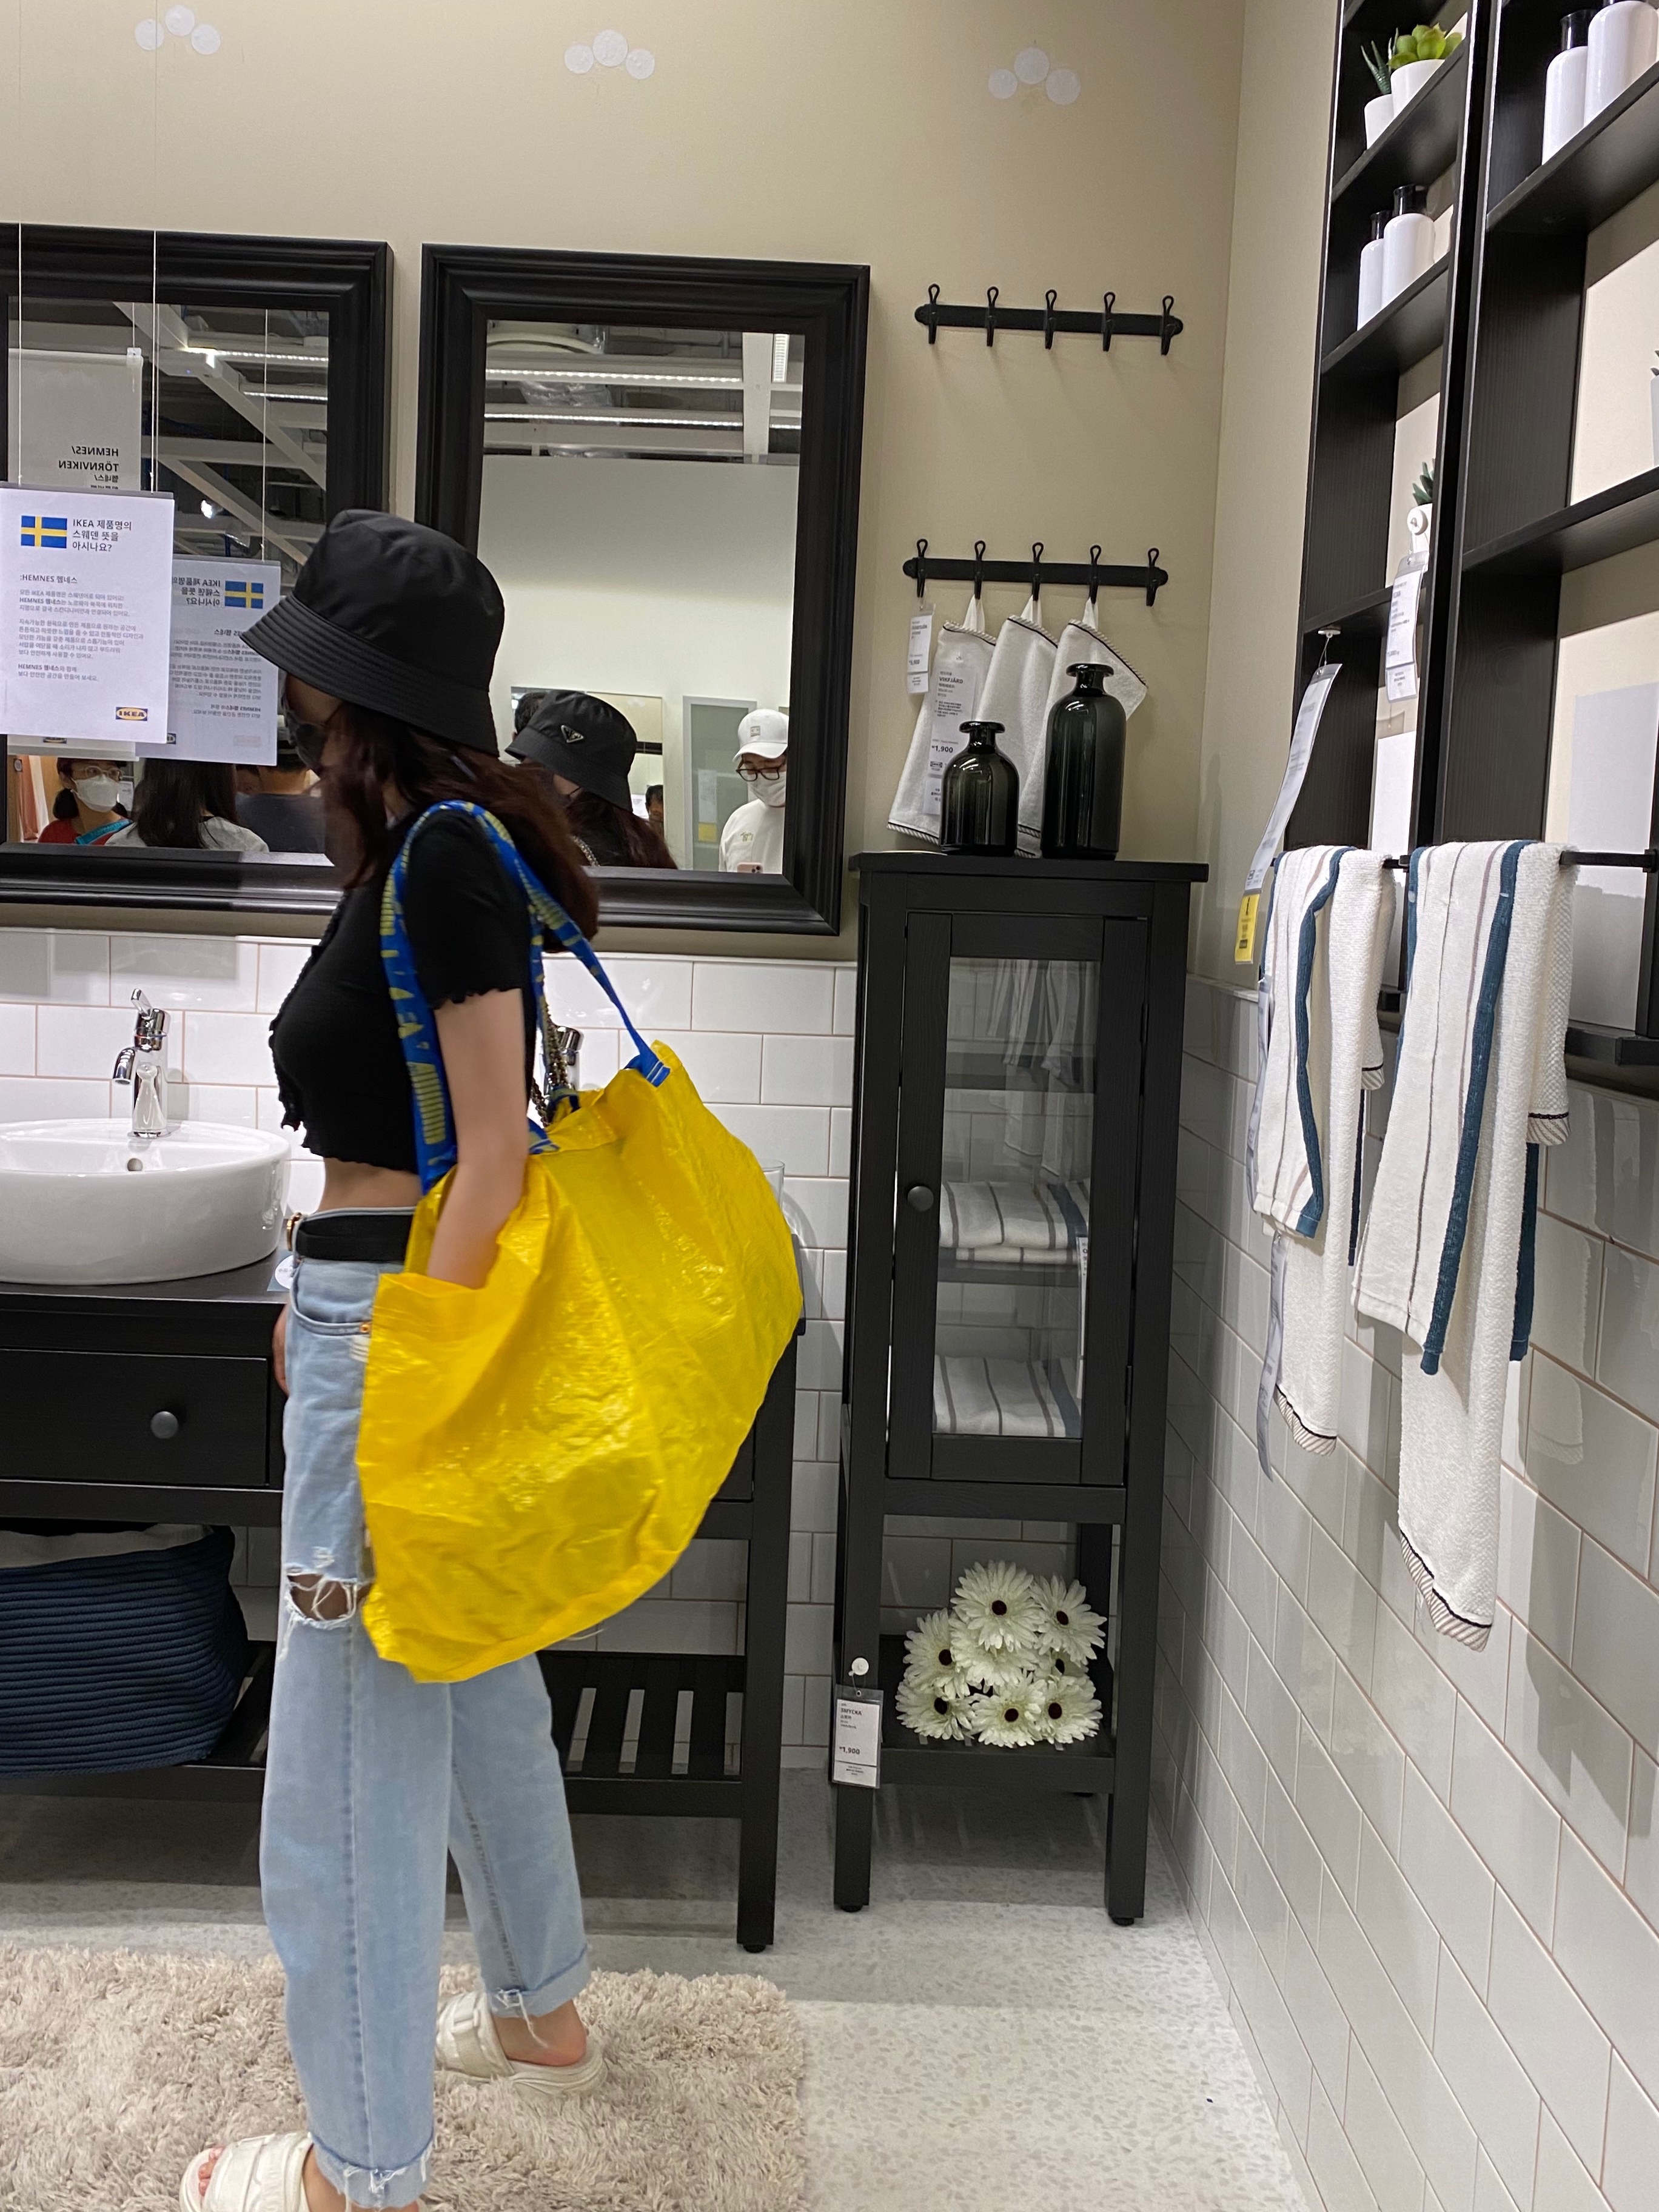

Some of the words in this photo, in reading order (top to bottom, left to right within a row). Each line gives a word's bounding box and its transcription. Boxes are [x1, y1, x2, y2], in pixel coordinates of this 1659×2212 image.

[73, 519, 94, 528] IKEA
[97, 520, 132, 531] 제품명의
[73, 530, 99, 540] 스웨덴
[102, 531, 119, 541] 뜻을
[72, 541, 112, 552] 아시나요?
